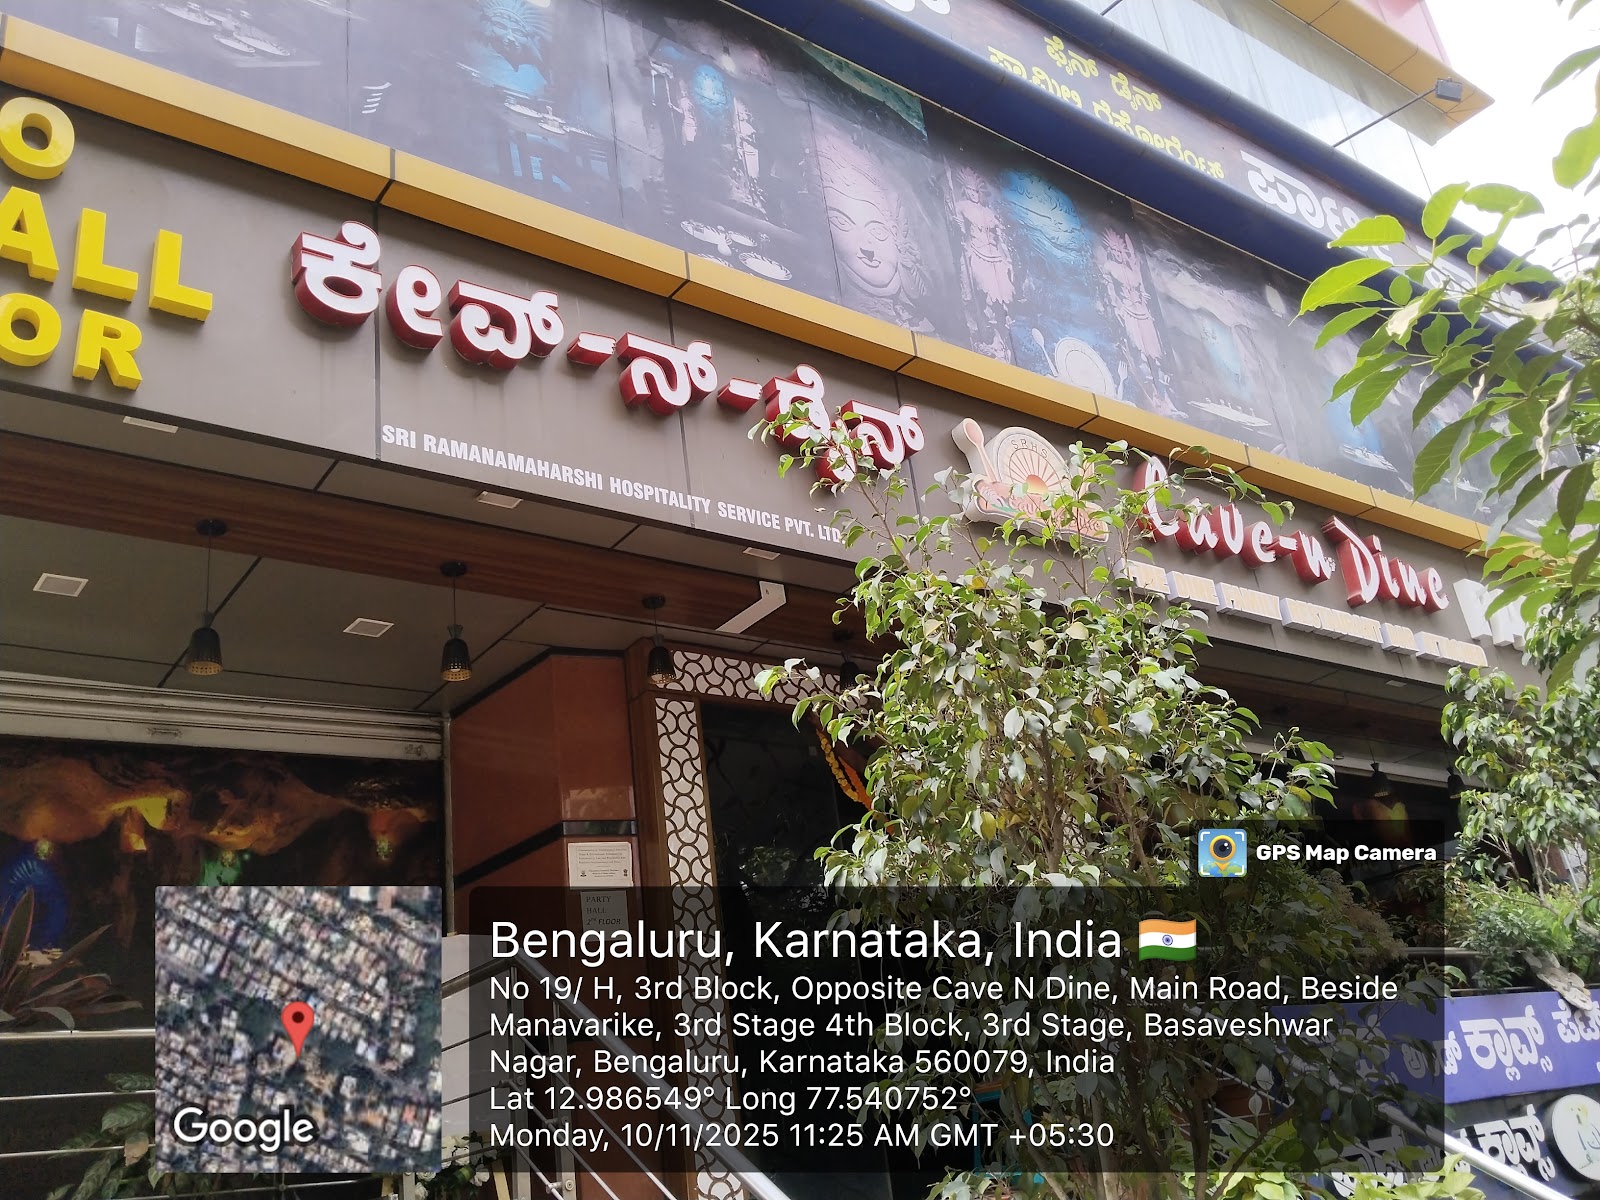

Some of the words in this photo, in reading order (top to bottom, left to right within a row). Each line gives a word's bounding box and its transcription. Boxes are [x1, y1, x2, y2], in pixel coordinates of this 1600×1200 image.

[382, 424, 416, 448] SRI
[423, 434, 603, 491] RAMANAMAHARSHI
[609, 477, 711, 514] HOSPITALITY
[718, 501, 781, 530] SERVICE
[785, 516, 815, 538] PVT.
[1010, 438, 1049, 459] SRHS
